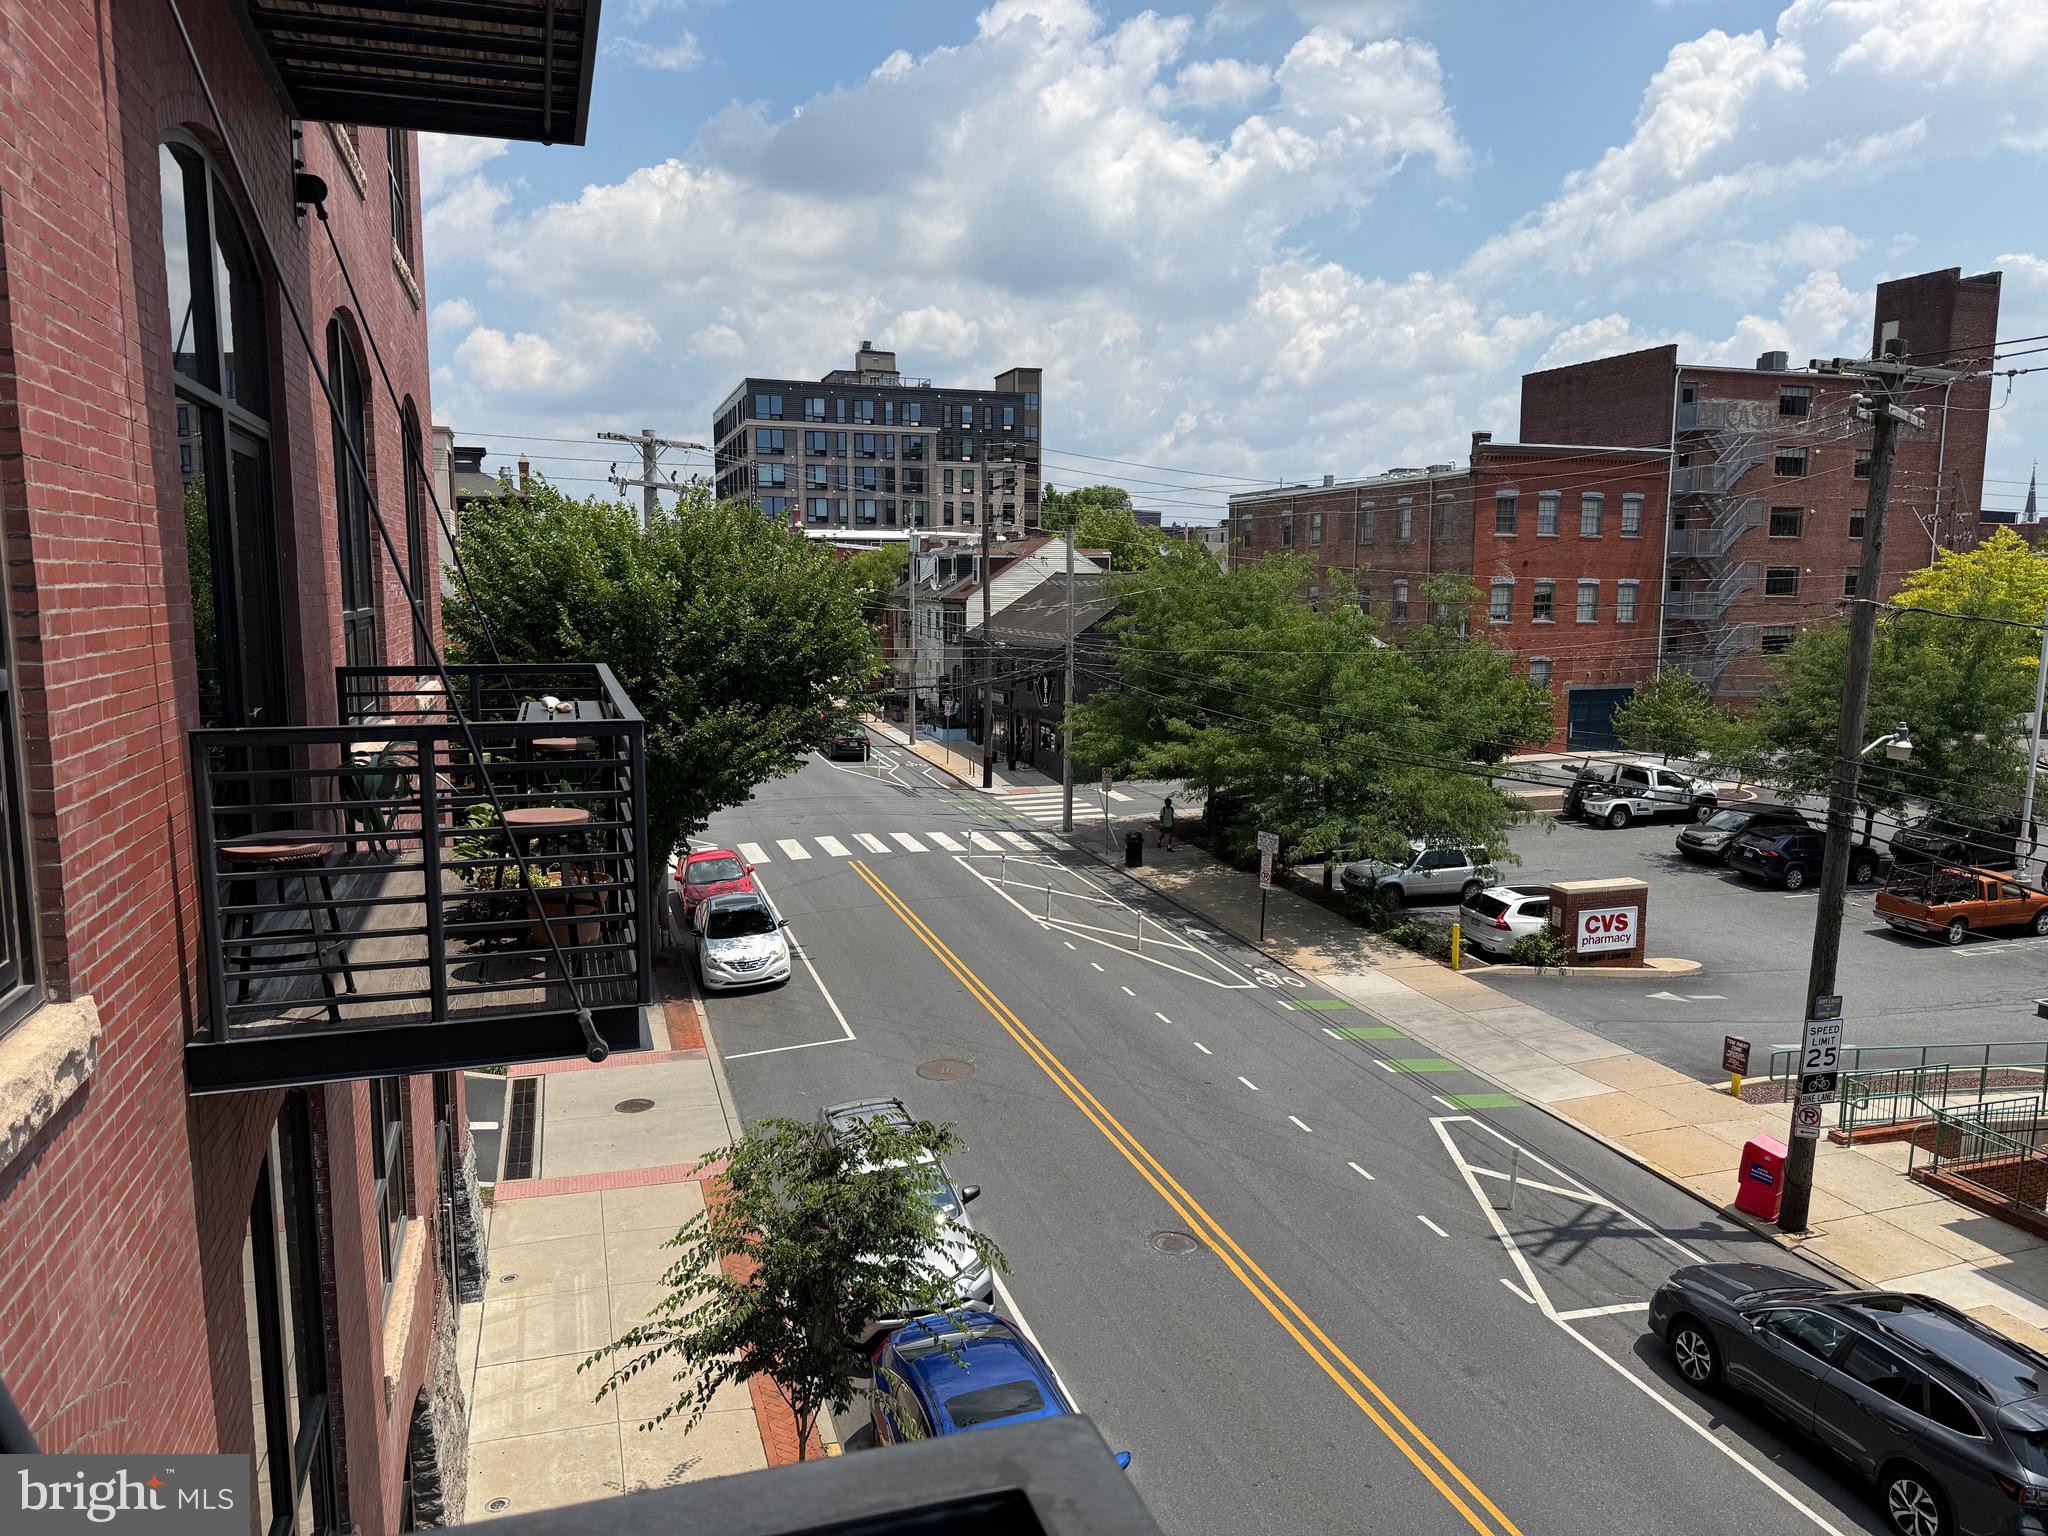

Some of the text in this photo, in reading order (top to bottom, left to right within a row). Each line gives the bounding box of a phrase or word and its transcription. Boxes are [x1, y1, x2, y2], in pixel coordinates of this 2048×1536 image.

[1585, 913, 1628, 934] CVS
[1582, 933, 1632, 947] pharmacy
[1810, 1025, 1840, 1035] SPEED
[1812, 1036, 1836, 1046] LIMIT
[1806, 1047, 1837, 1067] 25
[1802, 1092, 1832, 1104] BIKE LANE
